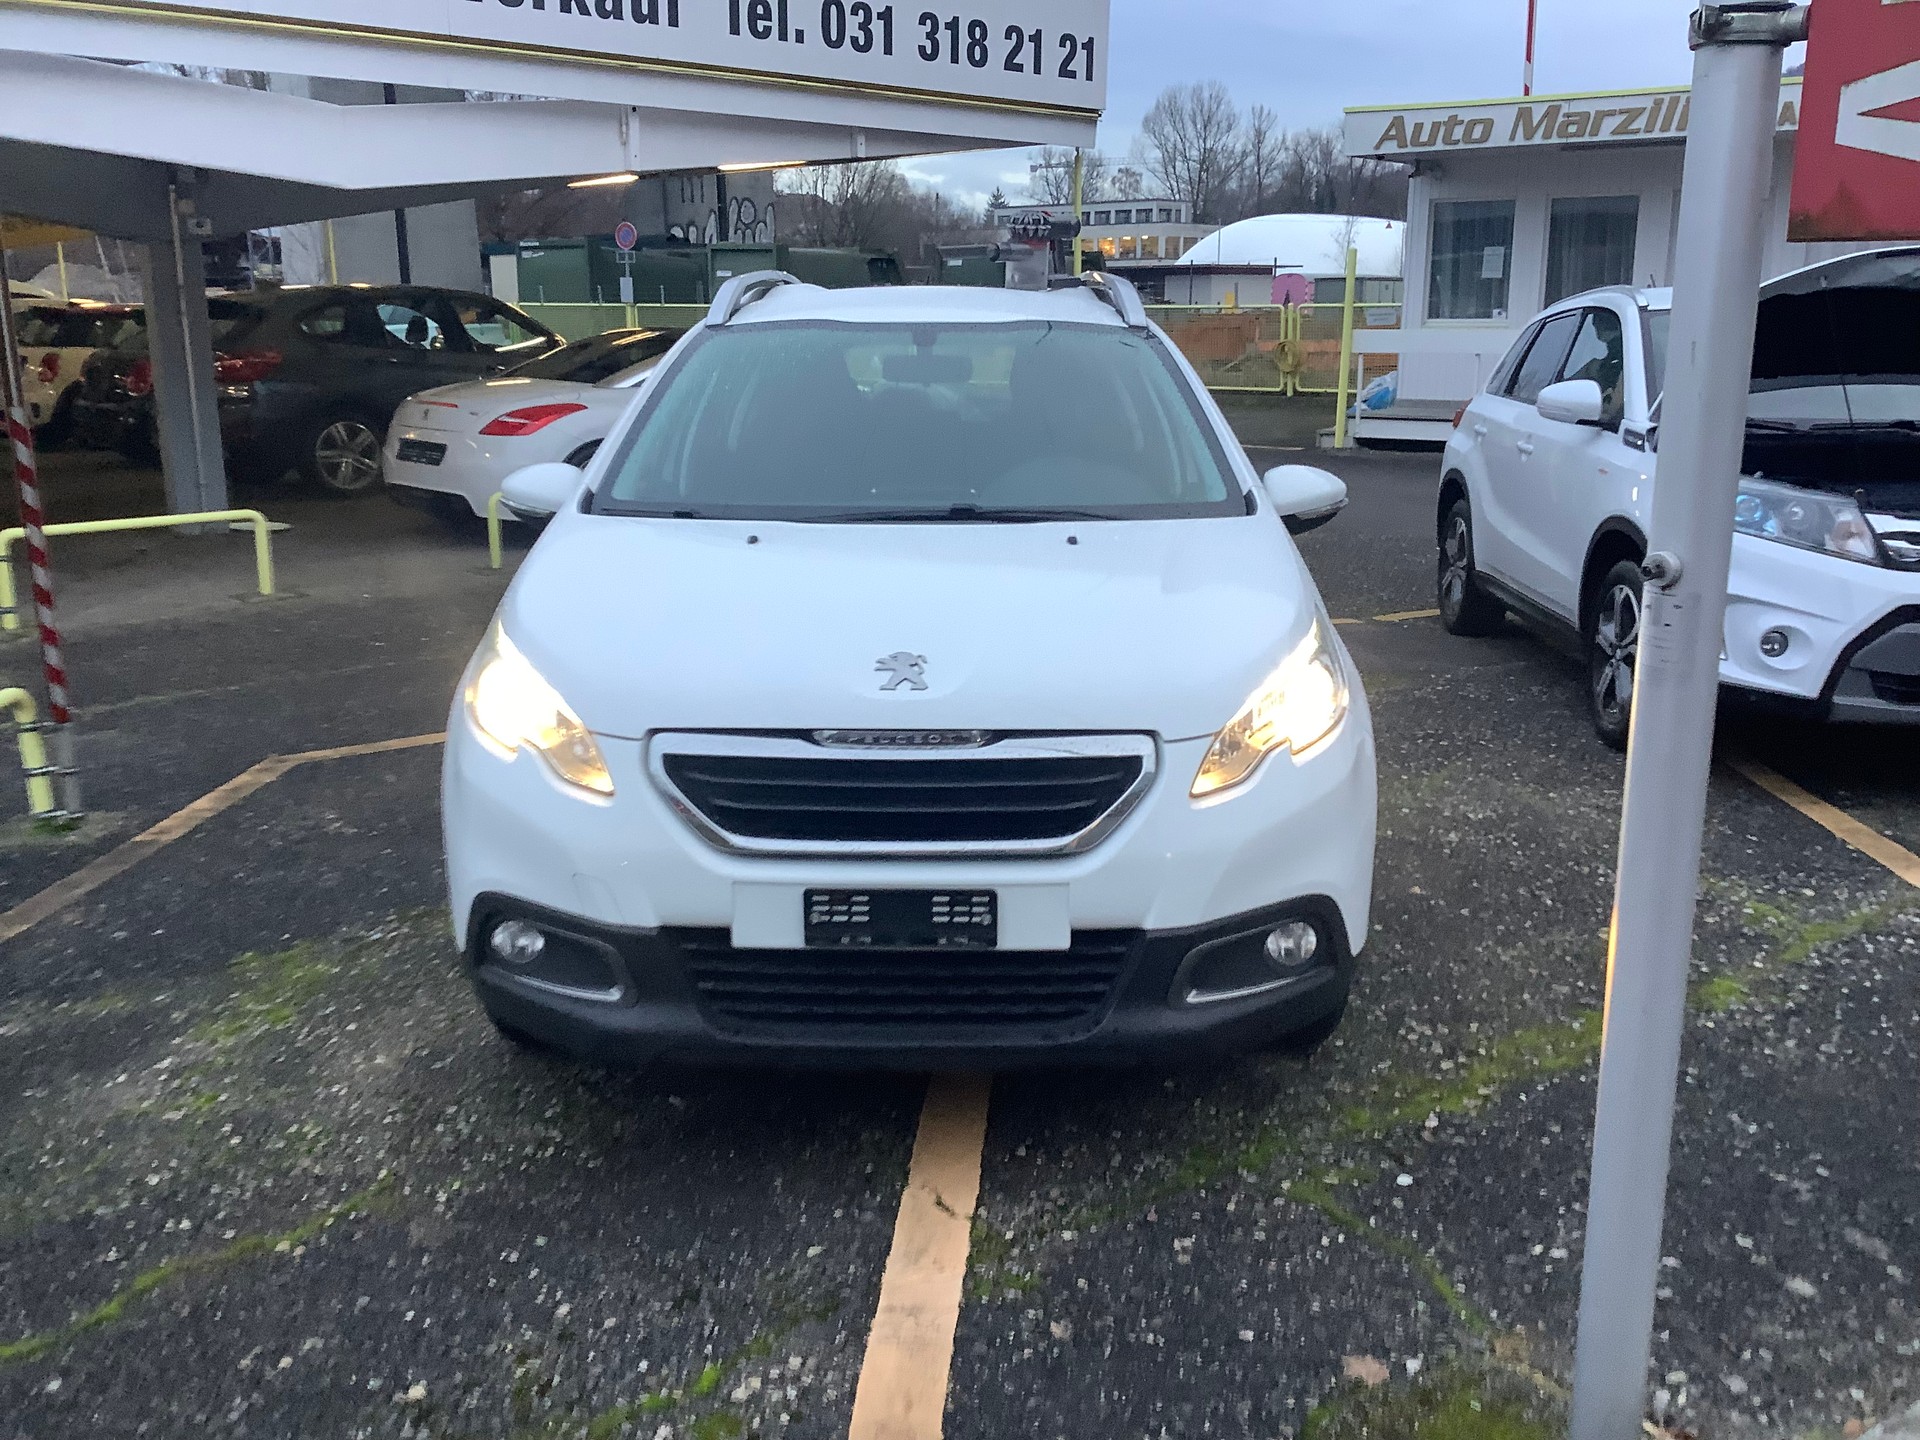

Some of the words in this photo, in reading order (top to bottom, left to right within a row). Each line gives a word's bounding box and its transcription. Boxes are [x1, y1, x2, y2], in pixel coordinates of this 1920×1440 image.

[821, 0, 893, 56] 031
[917, 11, 989, 68] 318
[1003, 24, 1042, 75] 21
[1058, 33, 1095, 82] 21
[1373, 114, 1494, 150] Auto
